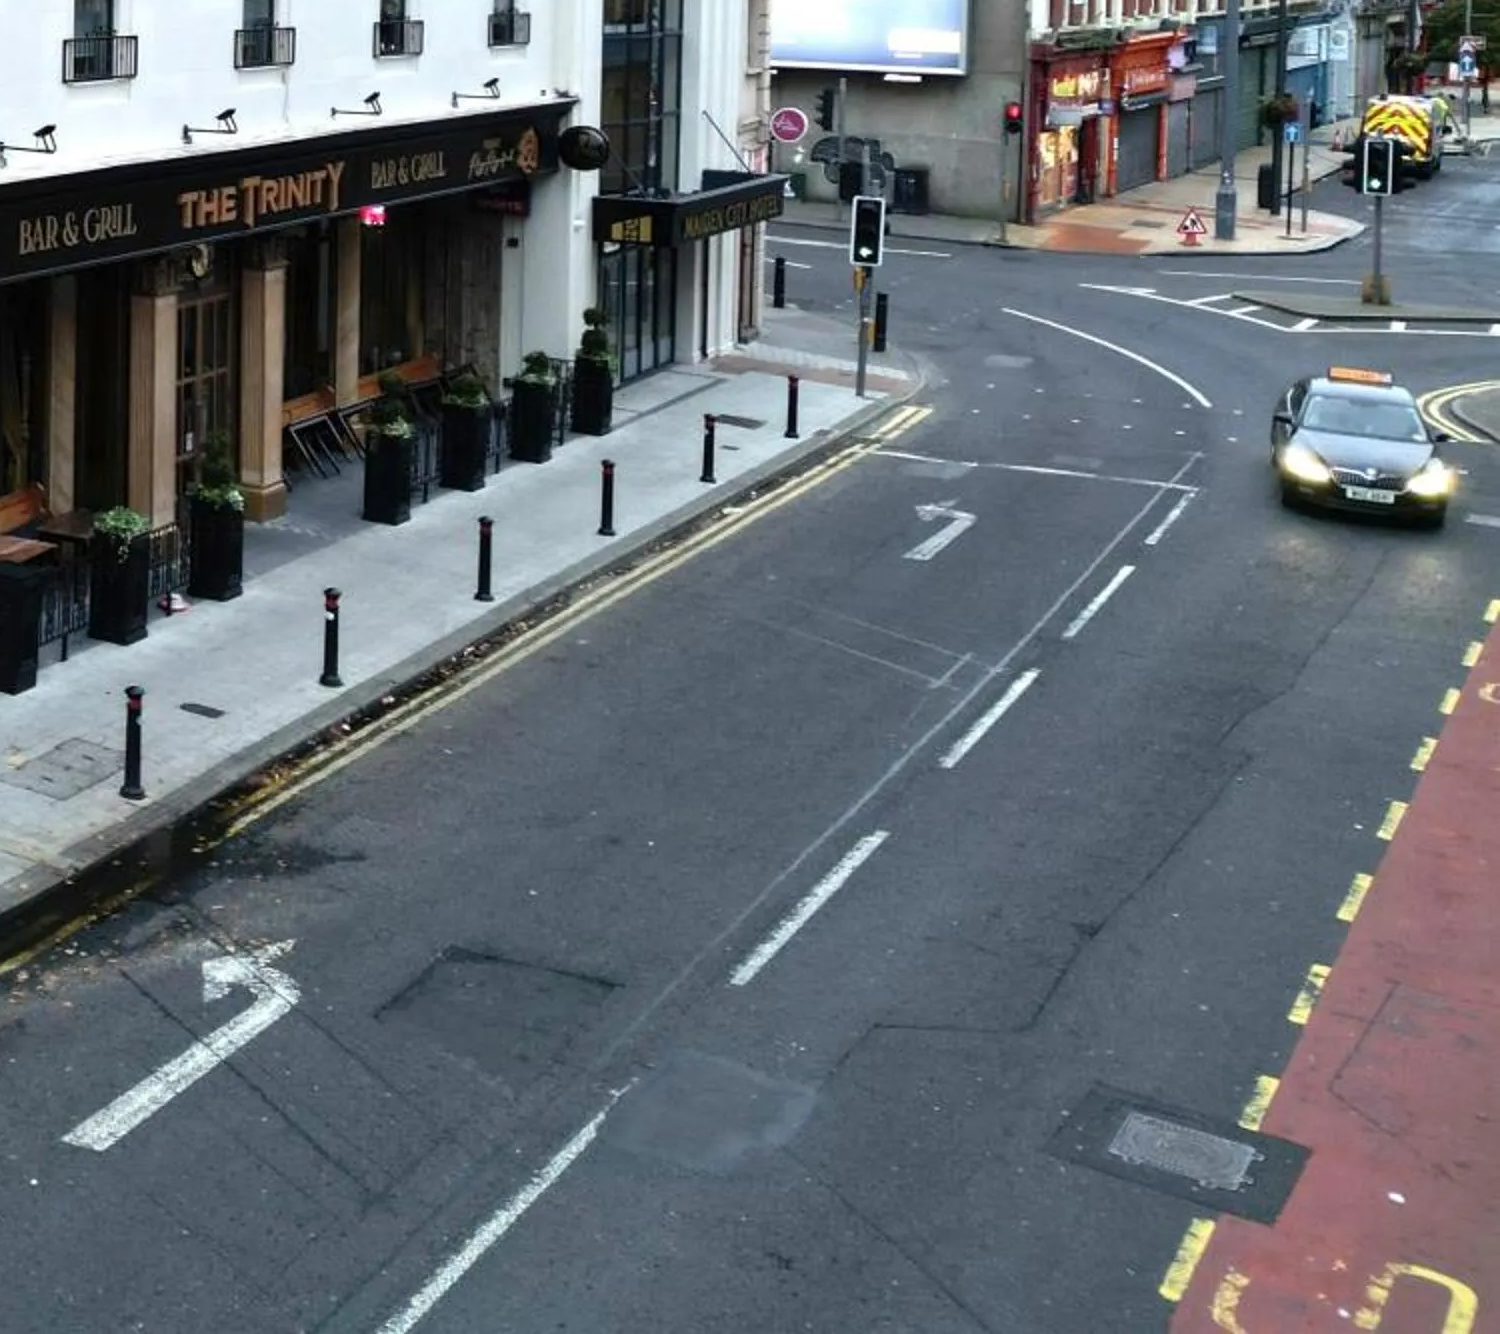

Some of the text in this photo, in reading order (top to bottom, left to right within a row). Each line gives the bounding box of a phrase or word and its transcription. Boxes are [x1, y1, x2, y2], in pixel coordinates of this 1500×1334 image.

[178, 160, 345, 229] THE TRINITY
[371, 159, 397, 189] BAR
[411, 151, 447, 181] GRILL
[19, 203, 137, 255] BAR & GRILL
